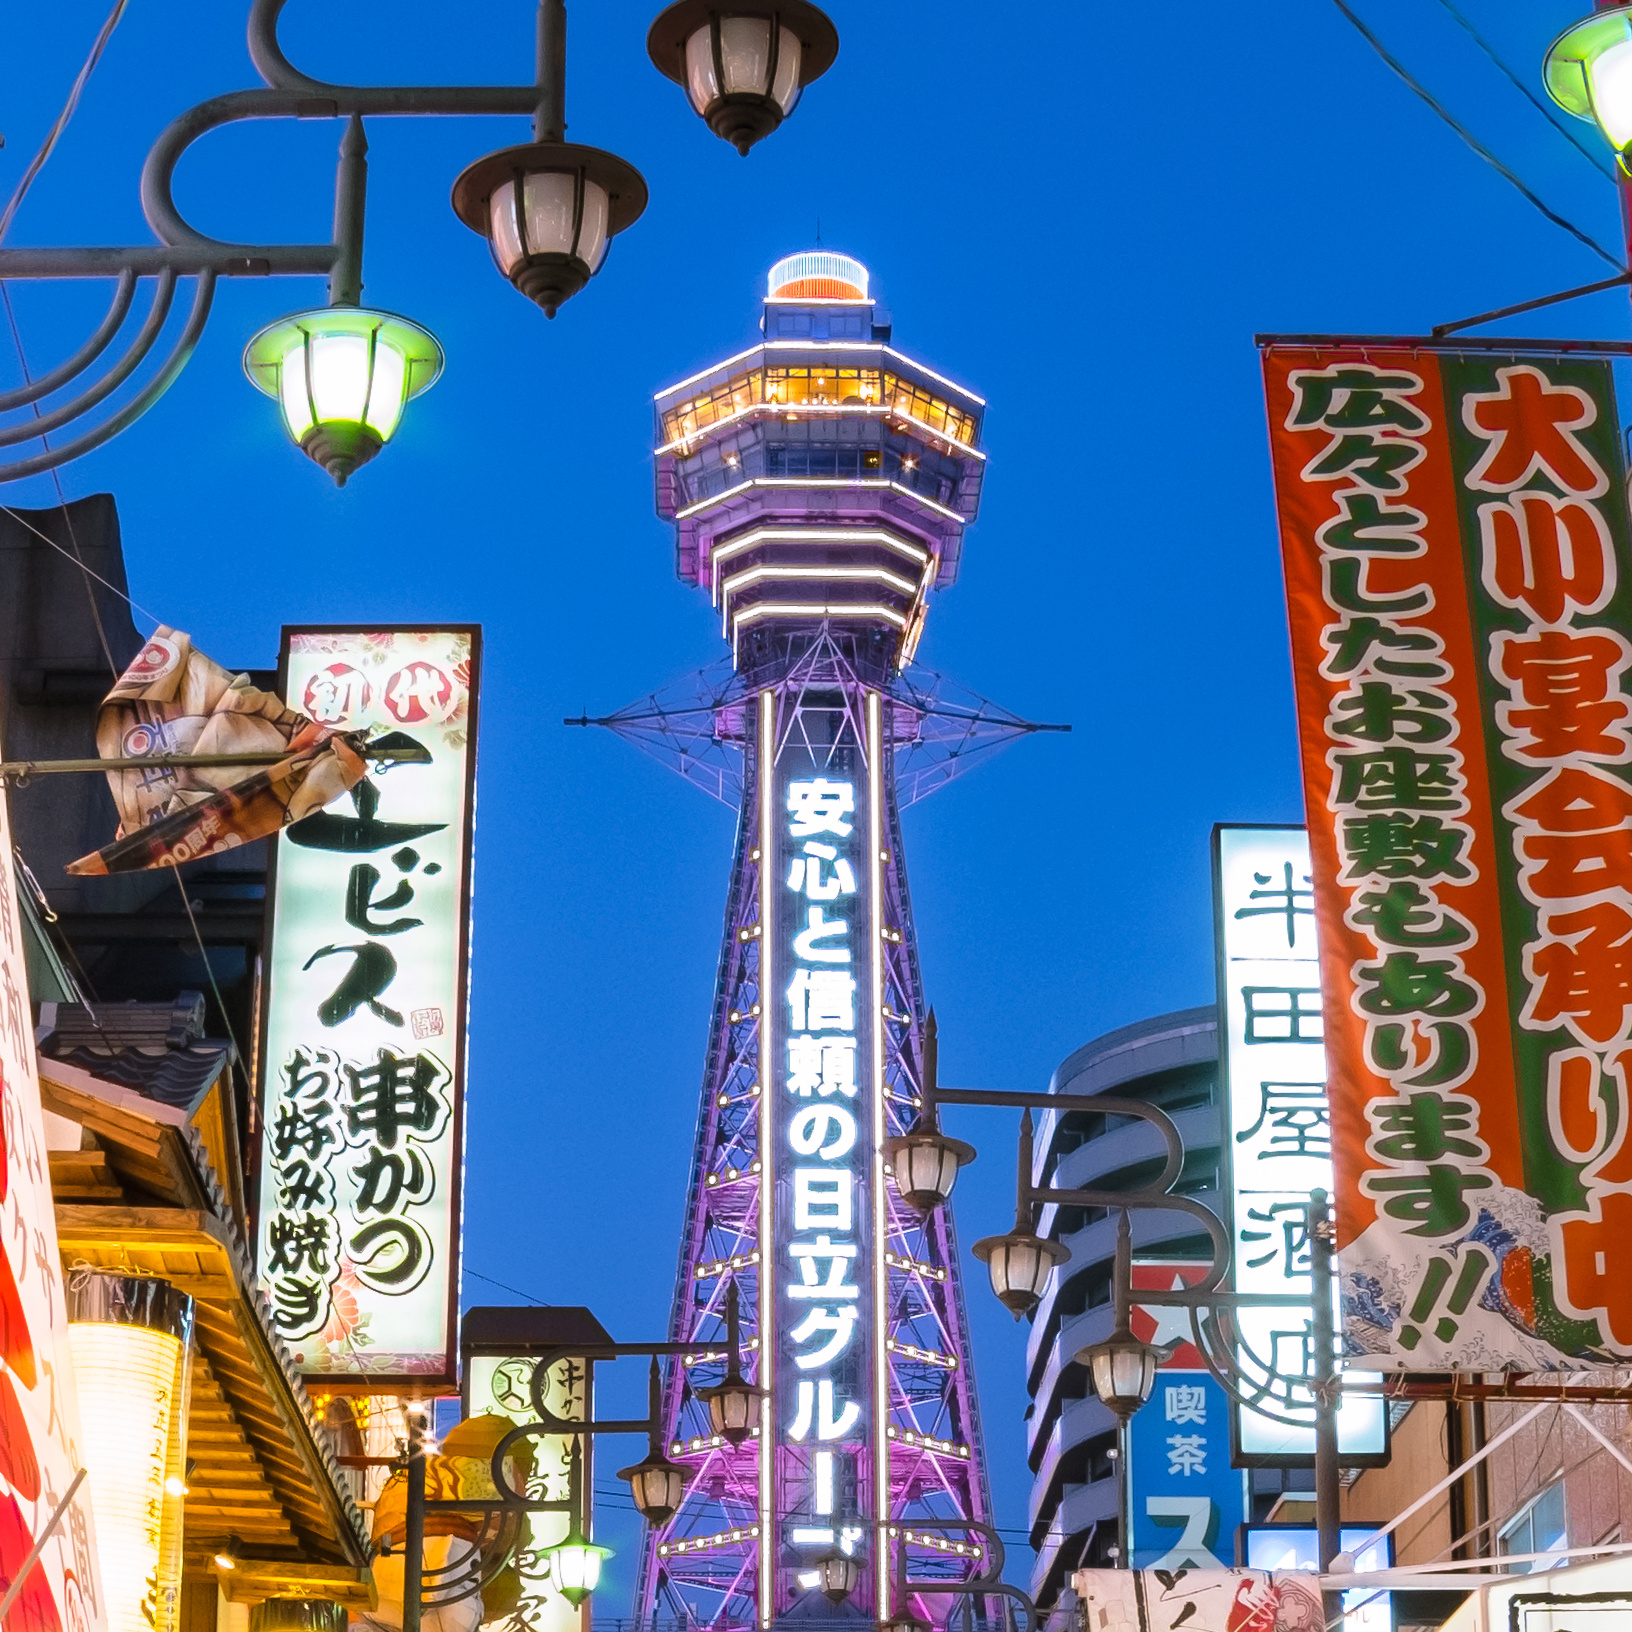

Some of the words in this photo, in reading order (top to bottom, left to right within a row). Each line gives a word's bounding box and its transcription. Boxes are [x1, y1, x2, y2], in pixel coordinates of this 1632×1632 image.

[305, 663, 452, 725] 初代
[286, 731, 449, 1029] エビス
[270, 1050, 340, 1332] お好み焼き
[341, 1048, 448, 1286] 串かつ
[787, 777, 862, 1591] 安心と信頼の日立グループ
[1165, 1384, 1209, 1477] 喫茶
